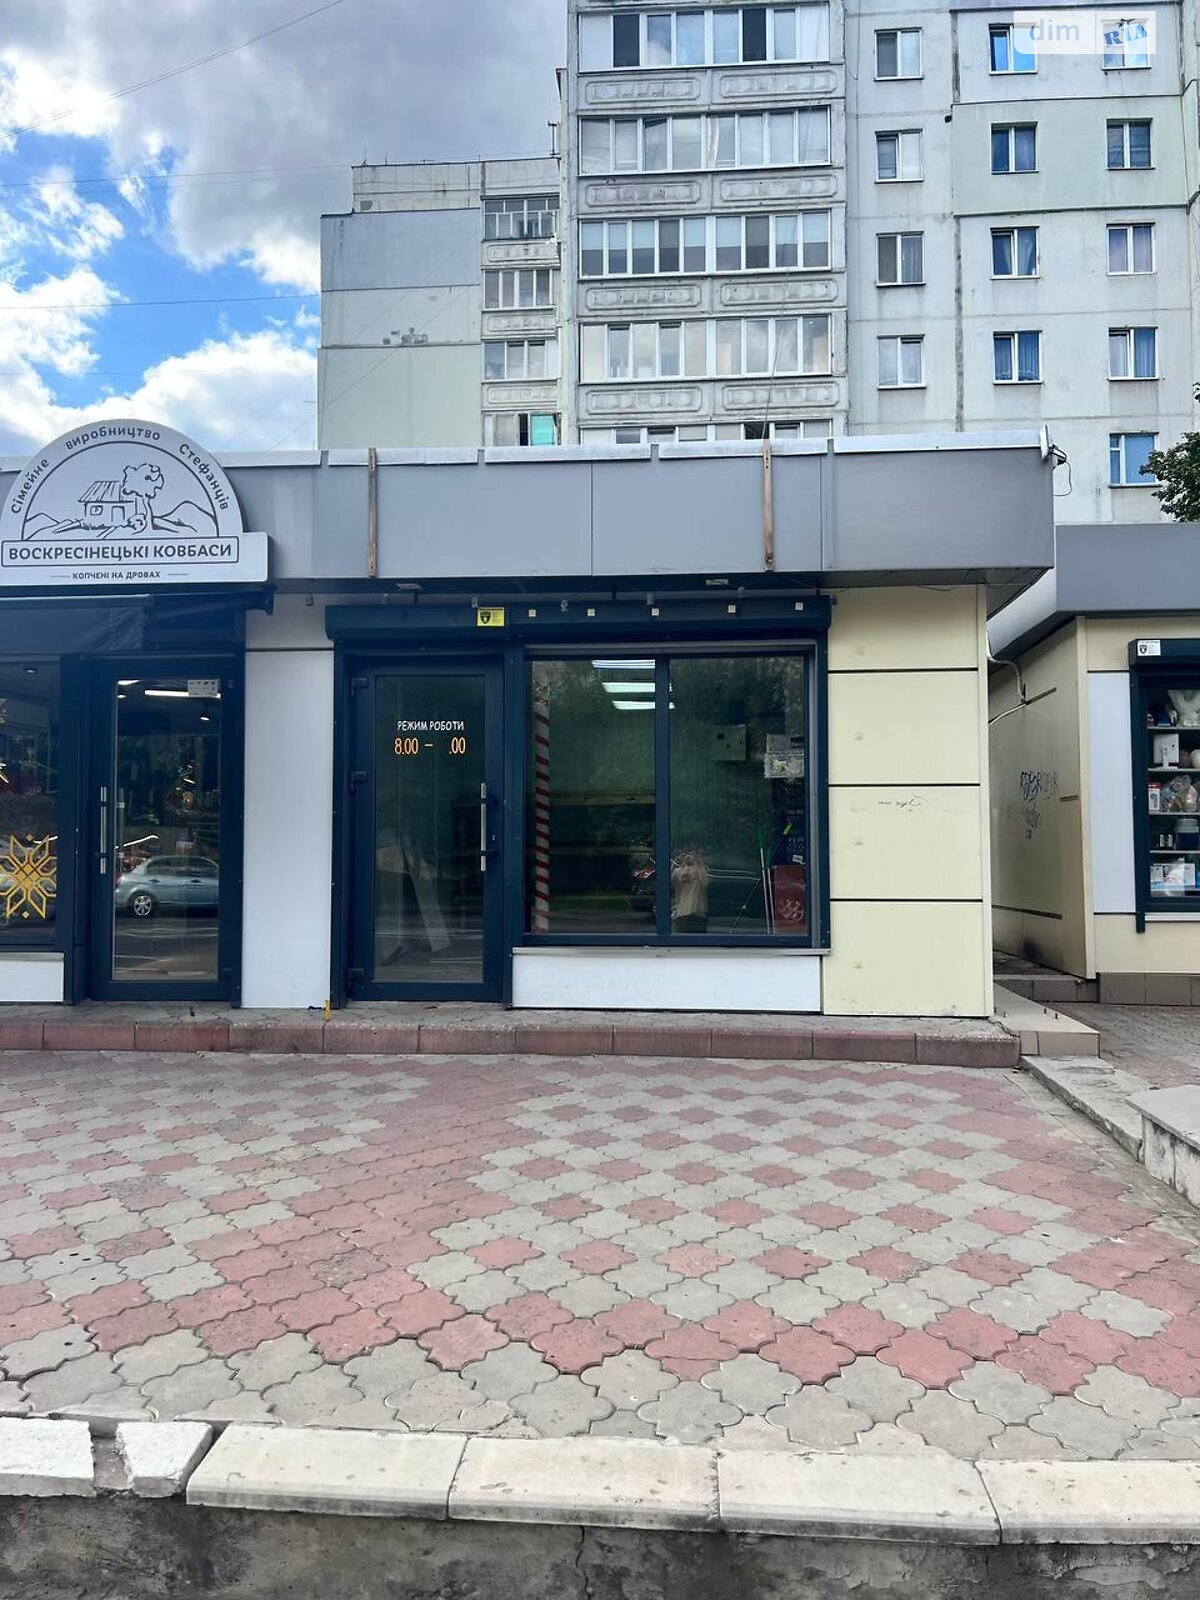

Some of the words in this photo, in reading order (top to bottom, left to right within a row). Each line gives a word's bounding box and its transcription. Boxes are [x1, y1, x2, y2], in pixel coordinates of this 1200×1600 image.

[11, 459, 49, 514] Сімейне
[65, 426, 161, 450] виробництво
[179, 443, 229, 510] Стефанців
[9, 545, 149, 561] ВОСКРЕСІНЕЦЬКІ
[154, 544, 232, 558] КОВБАСИ
[72, 572, 110, 580] КОПЧЕНІ
[126, 571, 161, 580] ДРОВАХ
[397, 721, 428, 731] РЕЖИМ
[429, 720, 465, 731] РОБОТИ
[394, 737, 419, 755] 8.00
